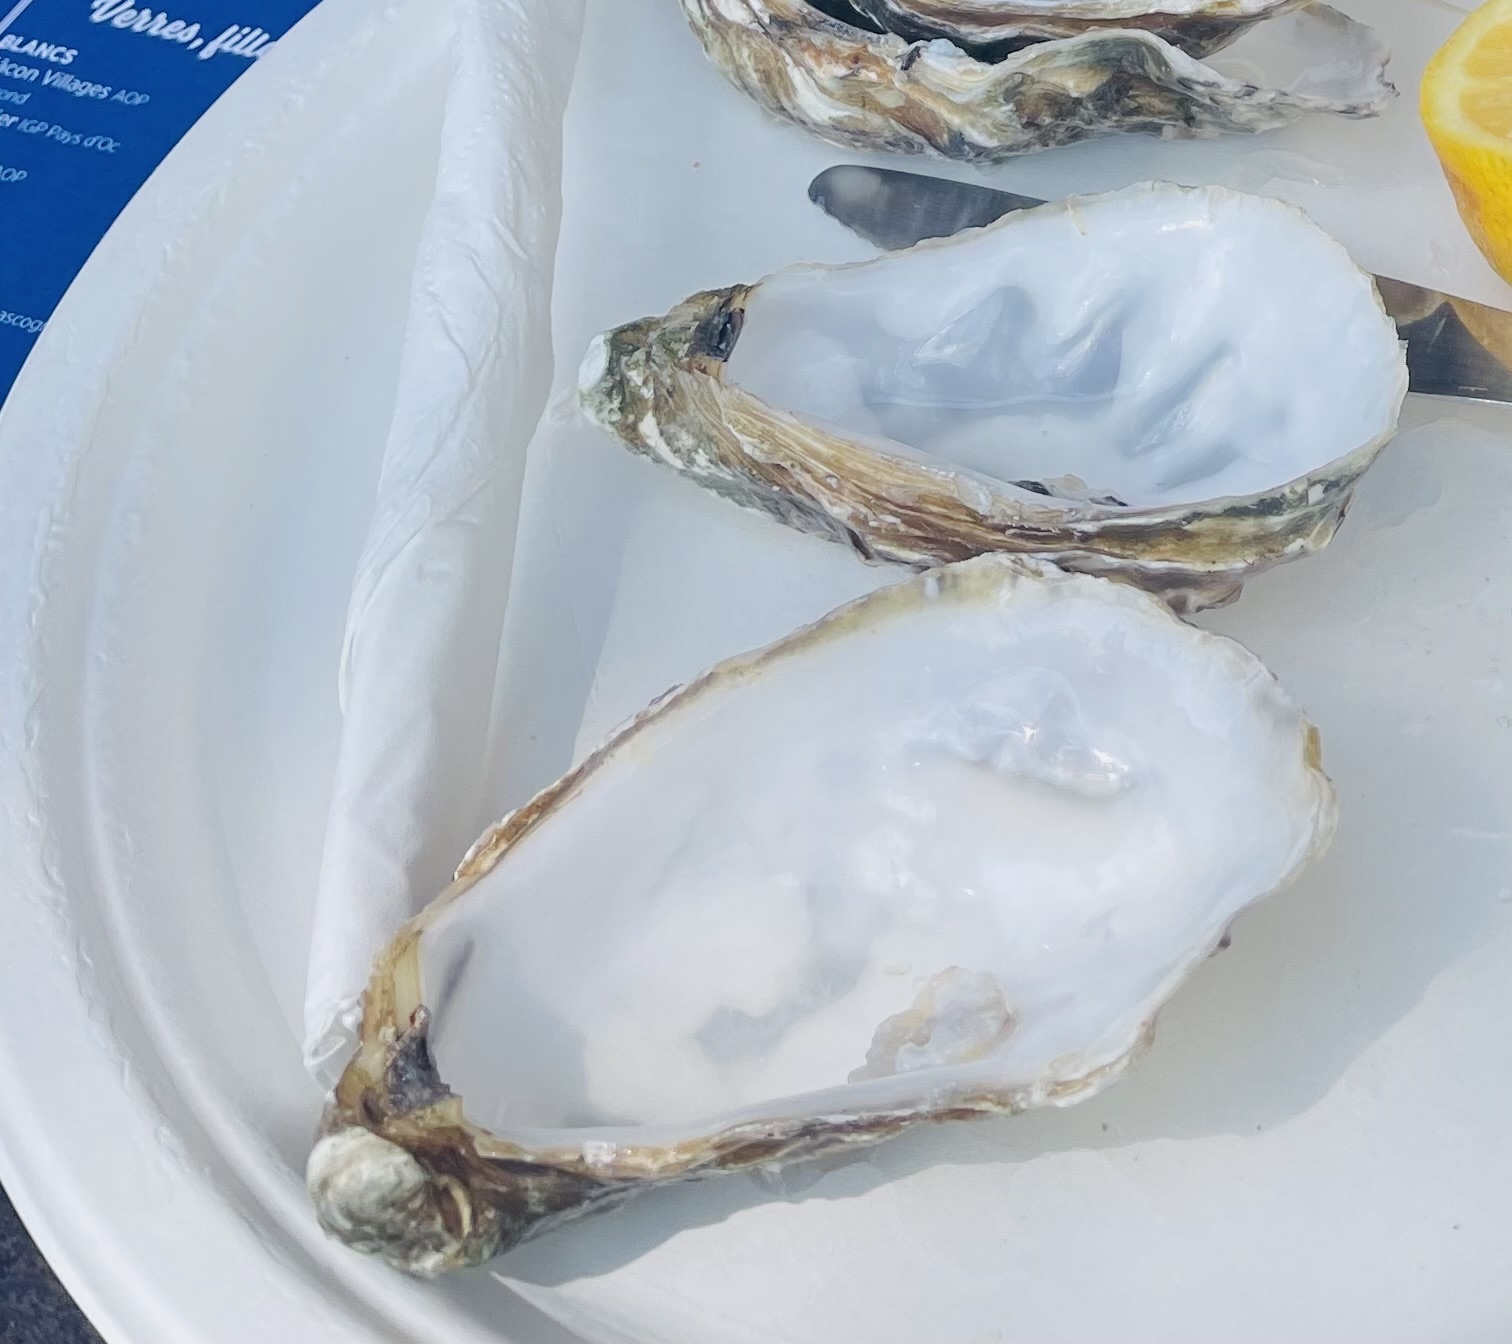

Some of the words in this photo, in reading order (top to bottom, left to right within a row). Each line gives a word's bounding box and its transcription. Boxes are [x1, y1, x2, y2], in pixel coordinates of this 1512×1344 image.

[0, 34, 79, 65] BLANCS
[0, 56, 40, 82] âcon
[41, 68, 112, 99] Villages
[109, 89, 151, 106] AOP
